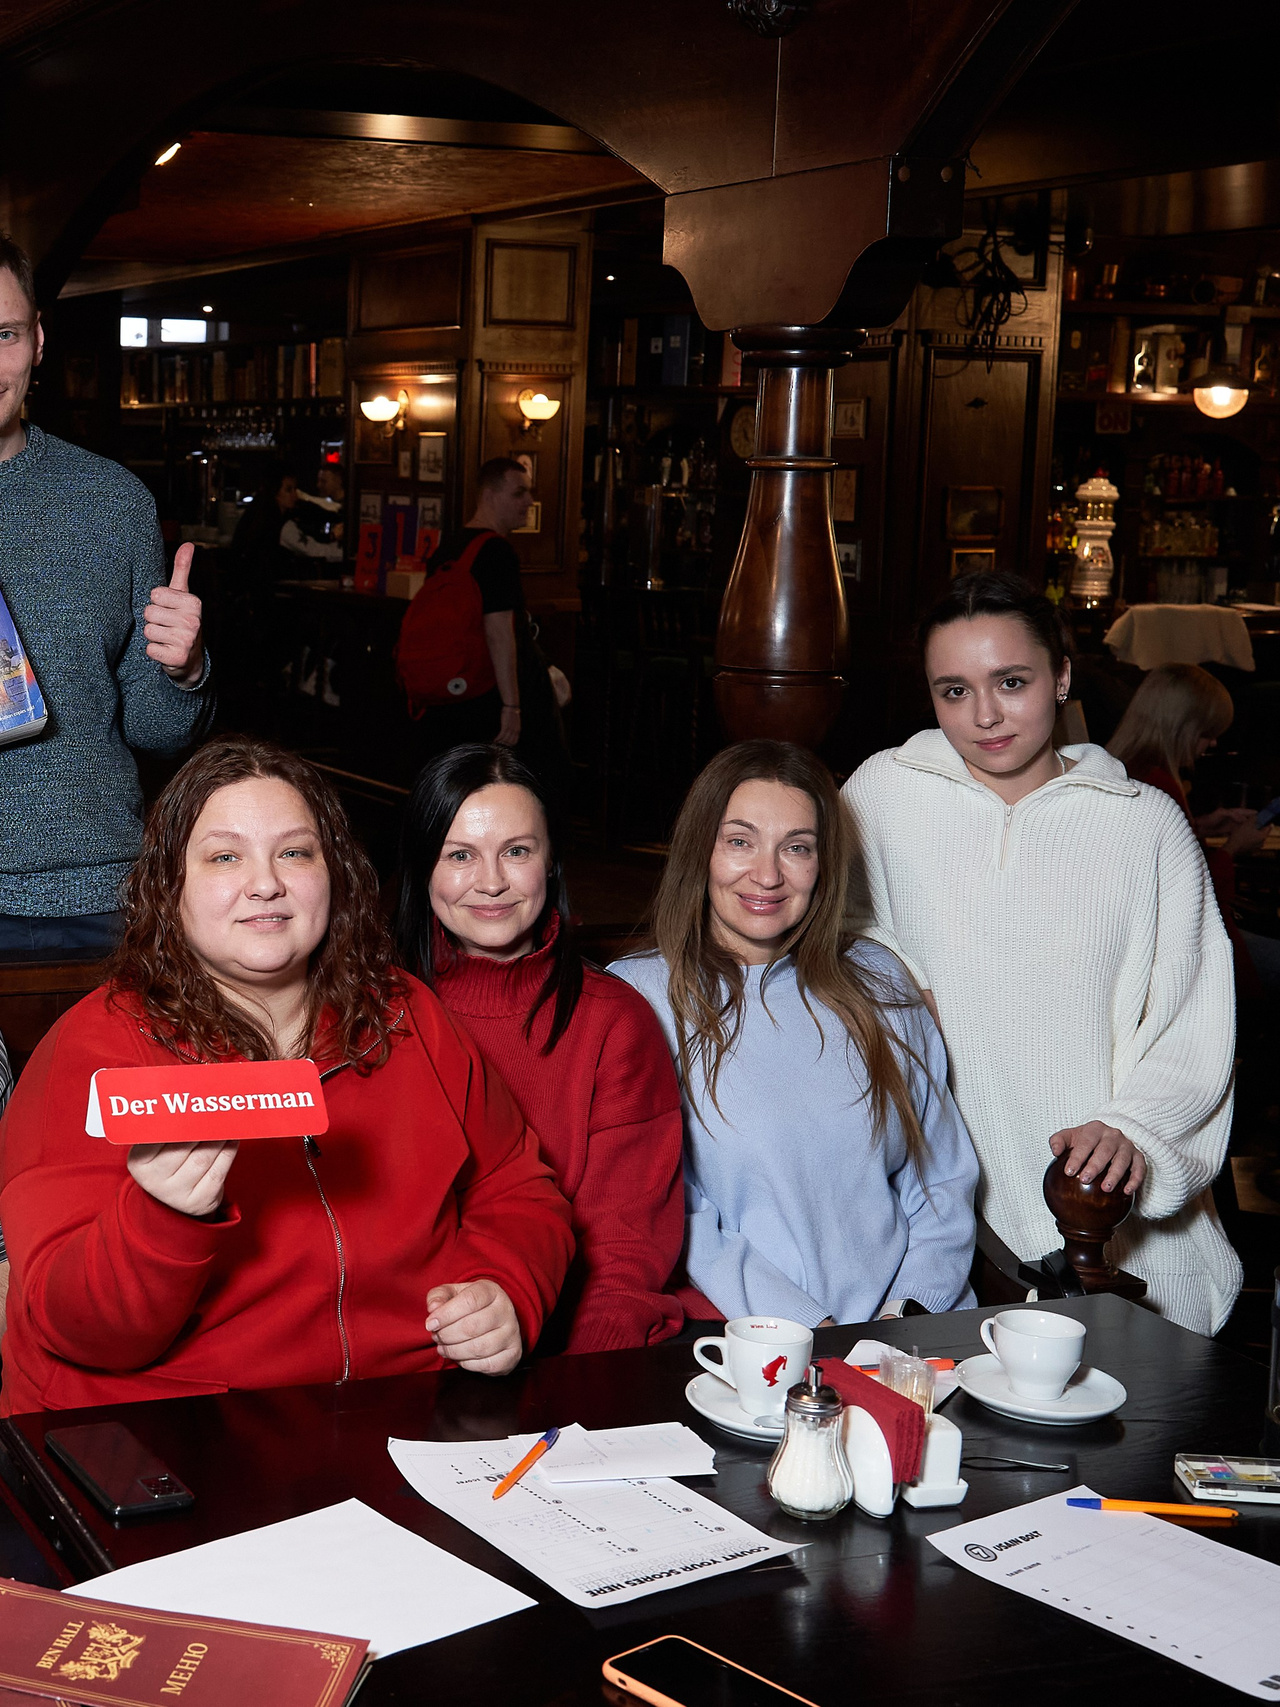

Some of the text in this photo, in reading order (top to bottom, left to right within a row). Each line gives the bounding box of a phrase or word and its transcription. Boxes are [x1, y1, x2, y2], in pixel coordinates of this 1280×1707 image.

[109, 1091, 315, 1117] Der Wasserman
[993, 1537, 1021, 1552] USAIN
[1019, 1530, 1043, 1542] BOLT
[722, 1545, 770, 1561] COUNT
[680, 1558, 722, 1573] YOUR
[1023, 1562, 1042, 1572] name
[625, 1569, 681, 1587] SCORES
[585, 1582, 626, 1598] HERE
[36, 1620, 85, 1670] BEN HALL
[160, 1642, 209, 1696] МЕНЮ
